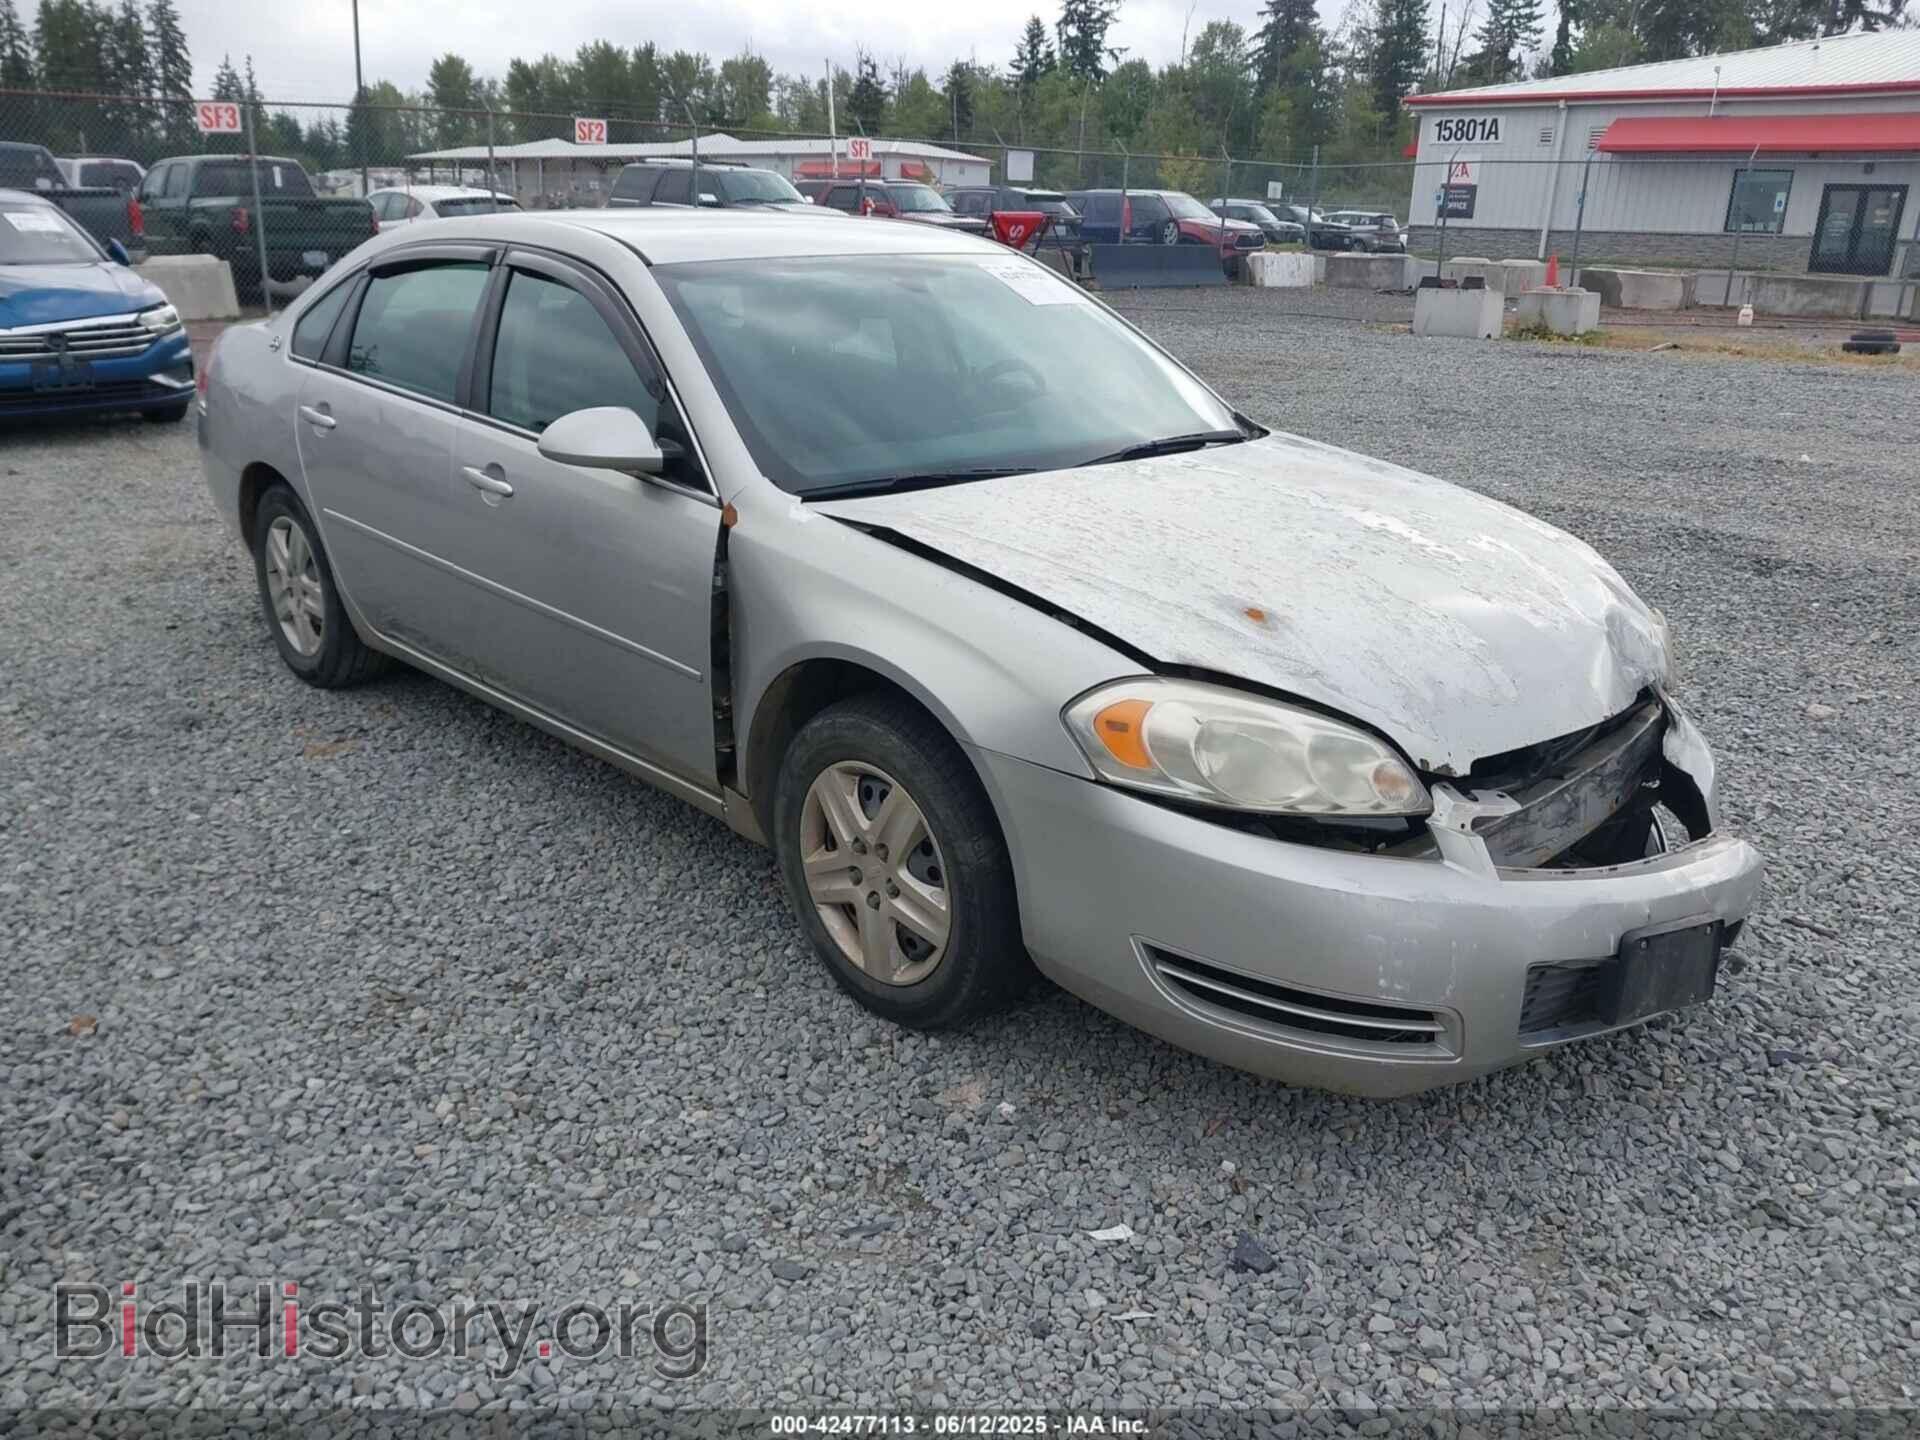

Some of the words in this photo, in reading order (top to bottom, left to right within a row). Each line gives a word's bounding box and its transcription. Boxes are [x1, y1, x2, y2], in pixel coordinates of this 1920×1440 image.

[200, 105, 238, 129] SF3
[577, 120, 605, 141] SF2
[1434, 117, 1500, 141] 15801A
[850, 139, 870, 158] SF1
